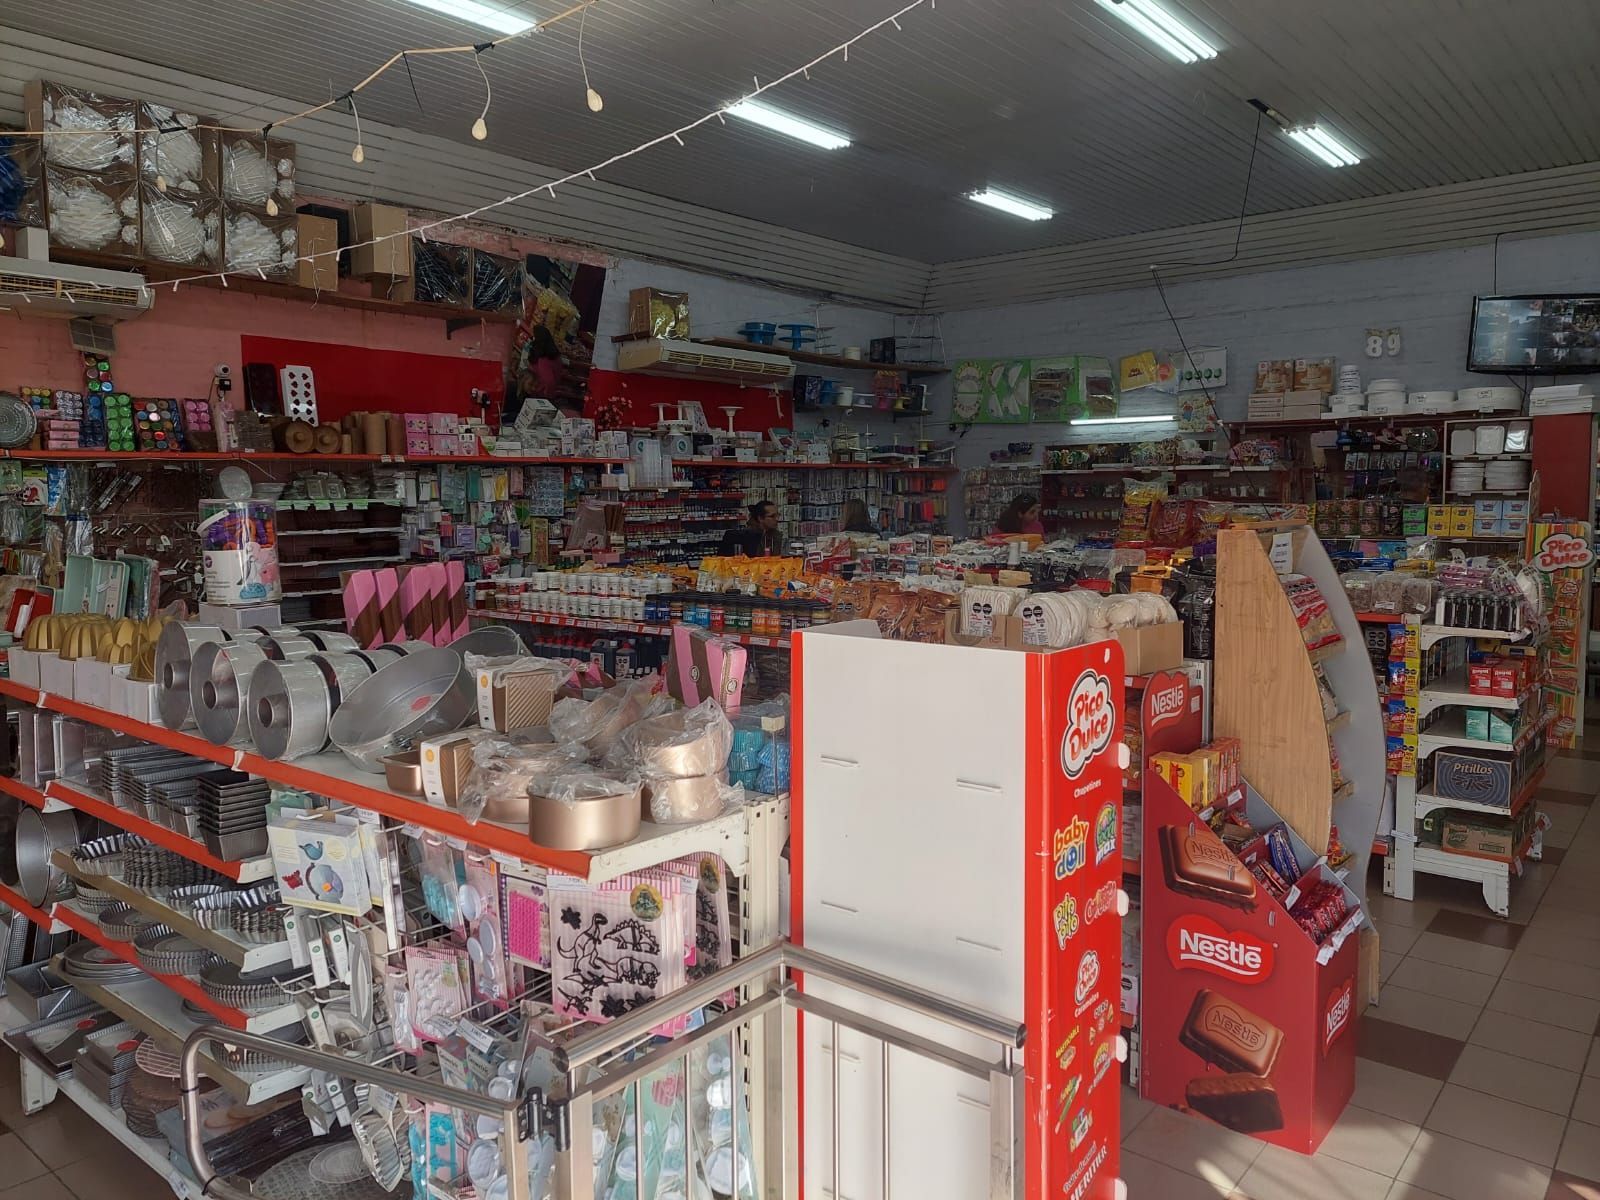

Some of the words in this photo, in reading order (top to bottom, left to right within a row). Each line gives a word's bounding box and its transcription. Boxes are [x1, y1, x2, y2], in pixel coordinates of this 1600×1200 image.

[1539, 551, 1589, 567] Dulce
[1546, 537, 1583, 552] Pico
[1074, 690, 1104, 721] Pico
[1151, 684, 1184, 715] Nestlé
[1069, 712, 1109, 760] Dulce
[1453, 763, 1494, 775] Pitillos
[1054, 815, 1089, 859] baby
[1055, 841, 1086, 880] doll
[1180, 929, 1262, 970] Nestlé
[1327, 988, 1351, 1034] Nestlé
